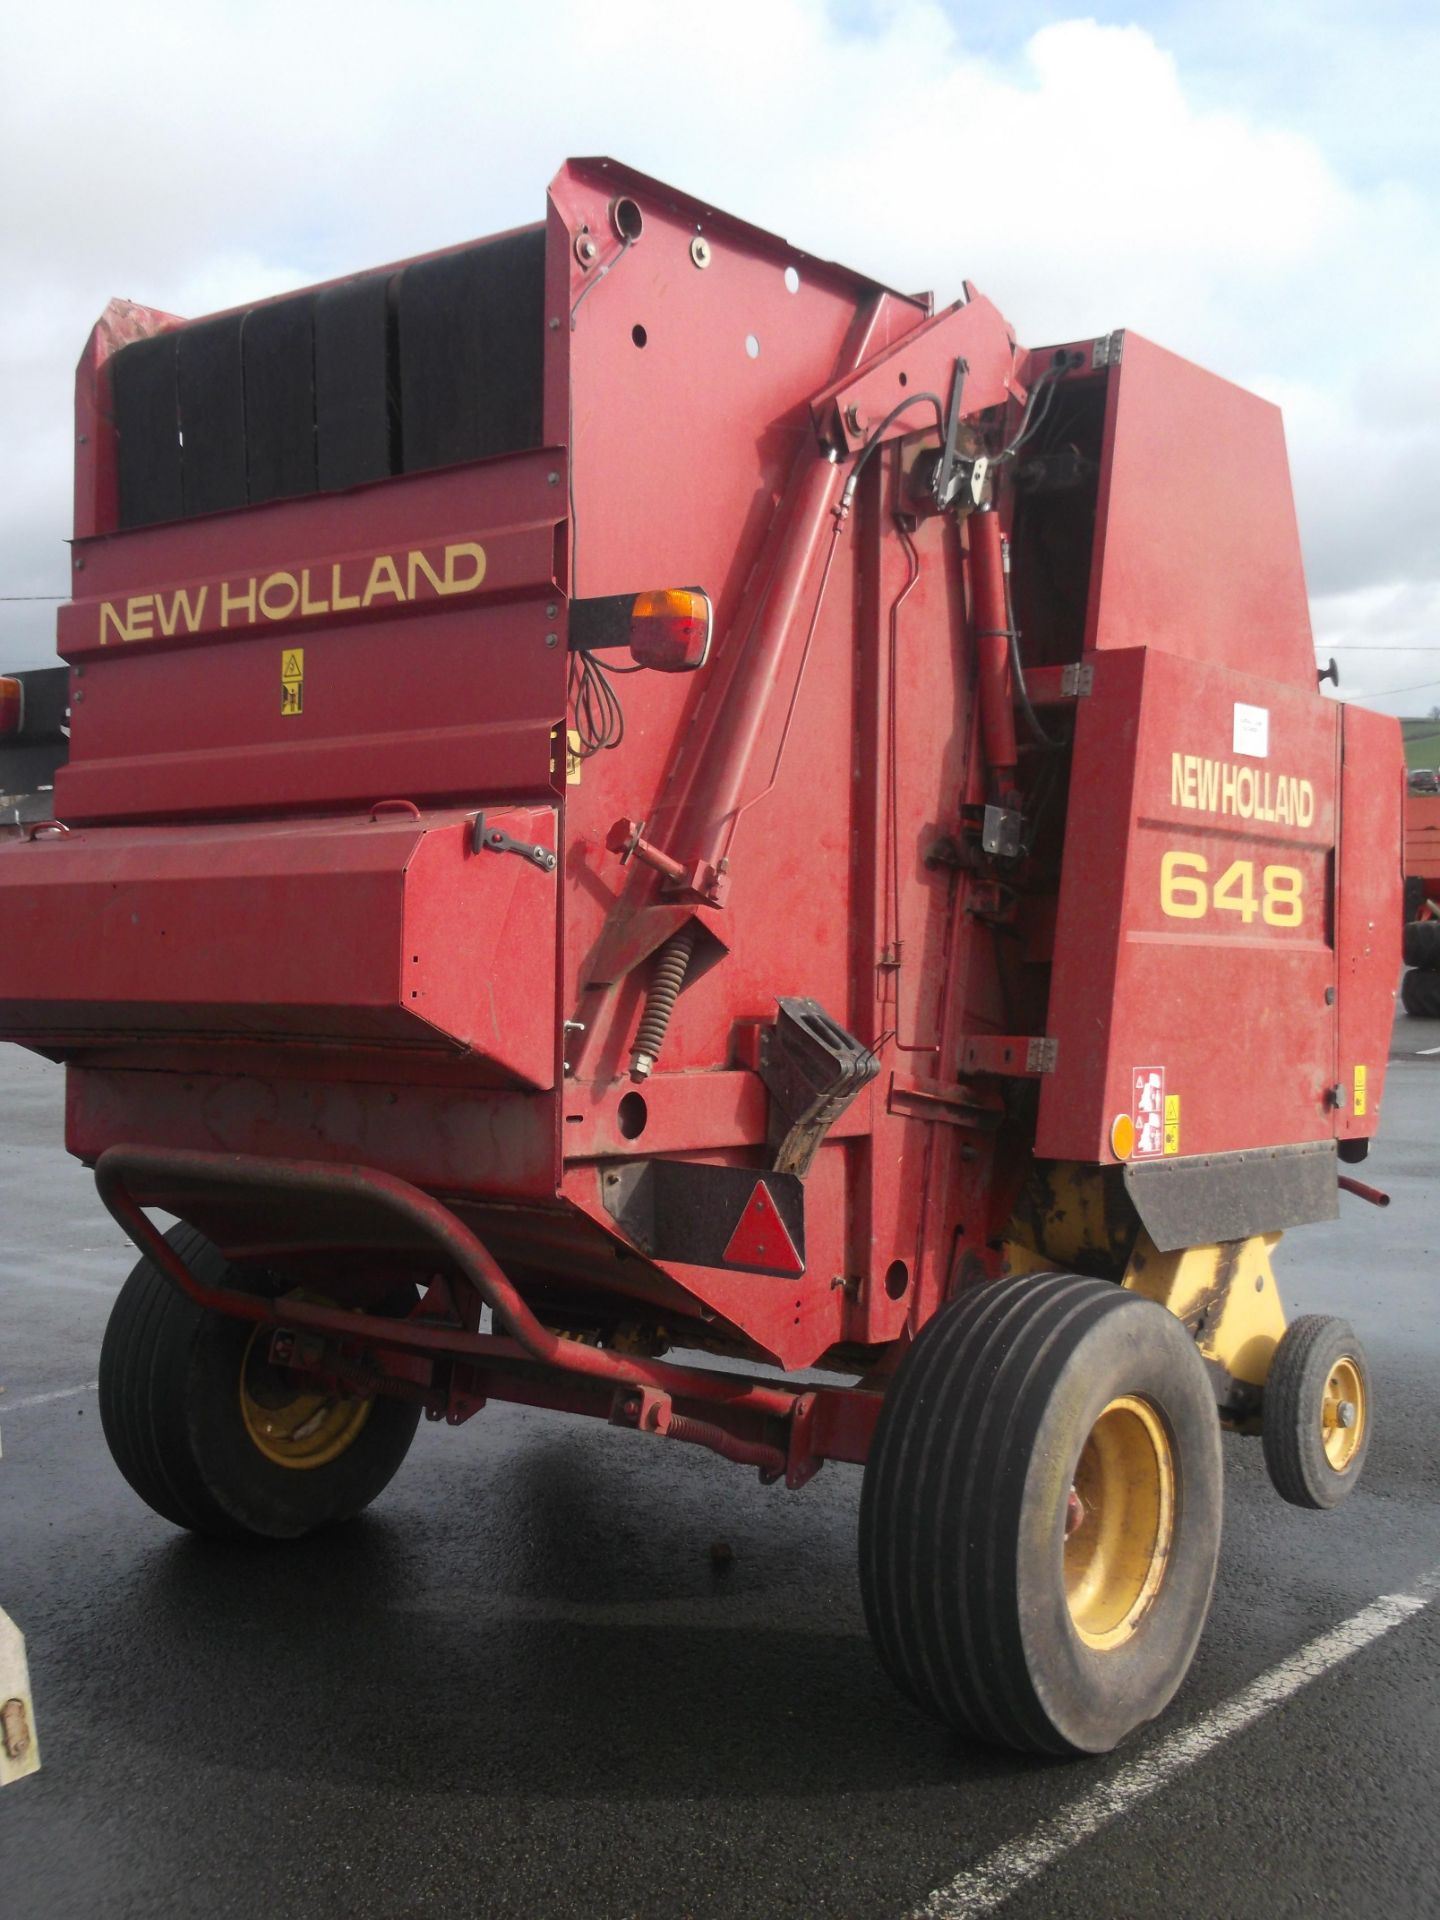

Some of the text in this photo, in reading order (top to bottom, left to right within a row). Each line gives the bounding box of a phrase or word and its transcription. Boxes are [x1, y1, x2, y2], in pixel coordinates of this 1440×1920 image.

[100, 542, 486, 644] NEW HOLLAND
[1171, 753, 1314, 827] NEW HOLLAND
[1161, 852, 1302, 926] 648
